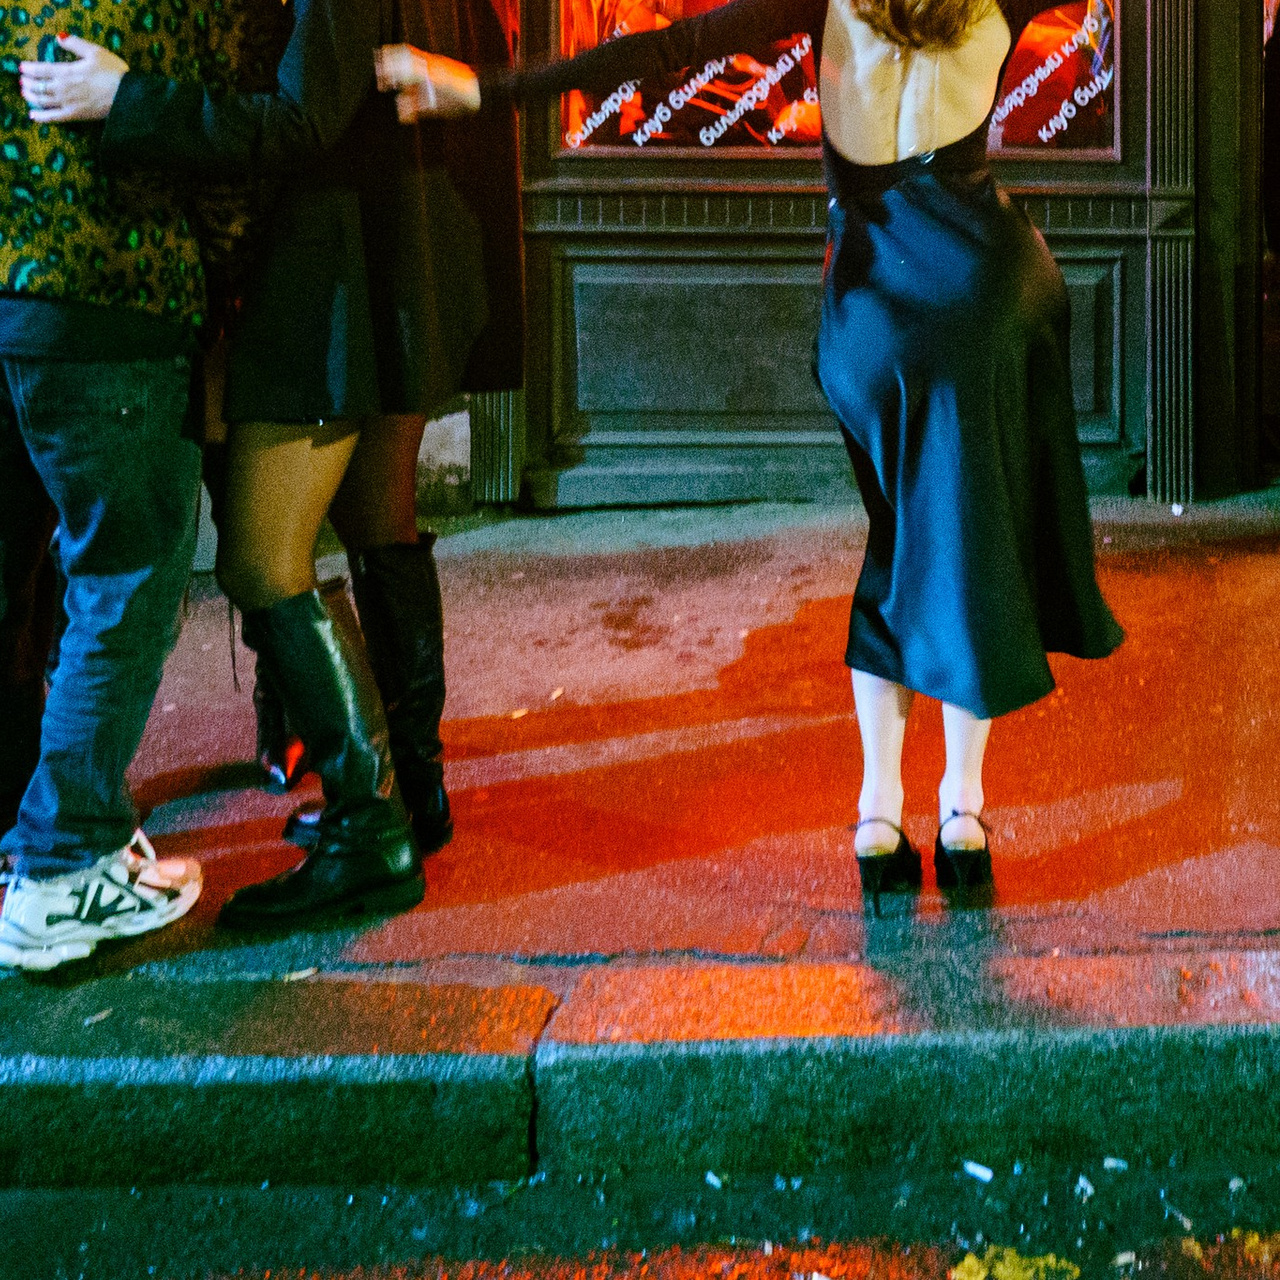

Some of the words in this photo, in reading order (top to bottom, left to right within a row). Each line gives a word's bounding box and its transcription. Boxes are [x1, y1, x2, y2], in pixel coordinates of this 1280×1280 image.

[699, 52, 795, 147] бильярдный
[1038, 99, 1076, 143] клуб
[633, 101, 672, 147] клуб
